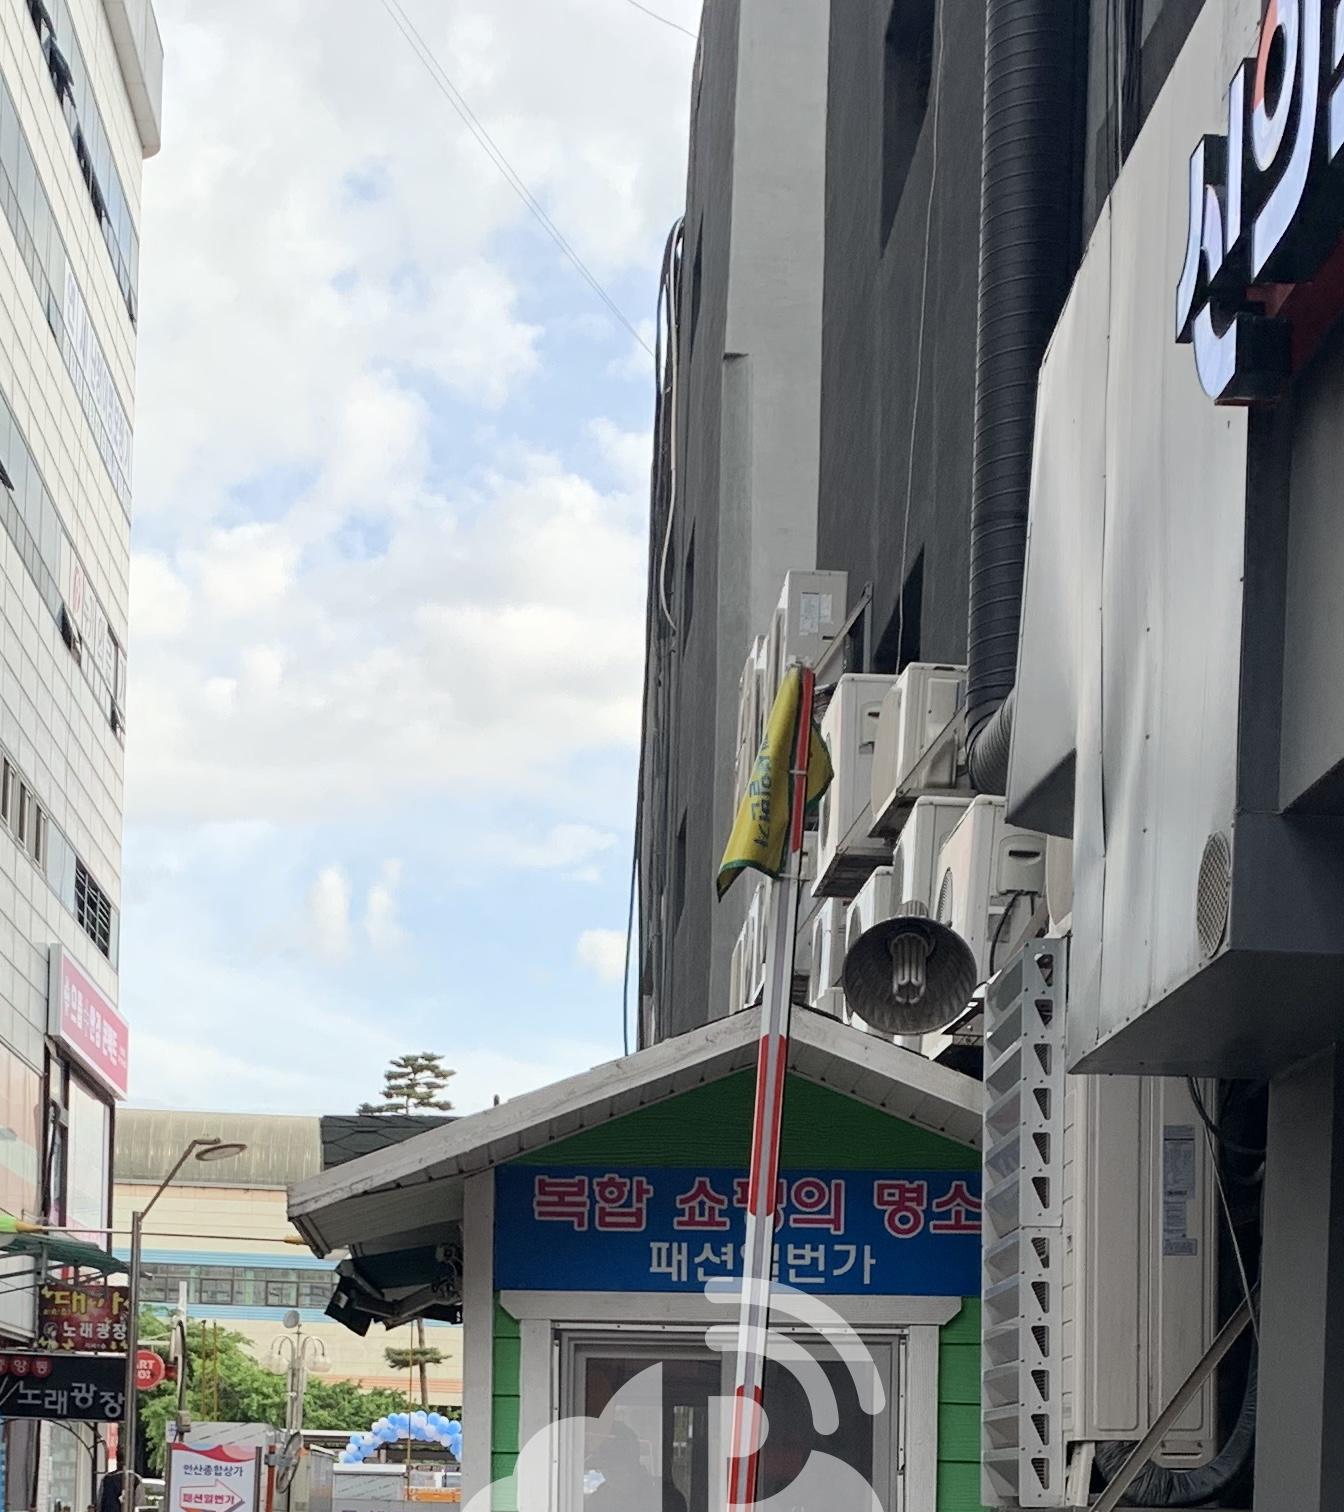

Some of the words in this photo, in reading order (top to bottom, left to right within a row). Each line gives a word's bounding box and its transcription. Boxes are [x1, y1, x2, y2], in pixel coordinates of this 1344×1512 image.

[534, 1174, 653, 1231] 복합
[873, 1180, 982, 1239] 명소
[62, 1321, 127, 1340] 노래광장
[17, 1381, 125, 1418] 노래광장
[183, 1464, 244, 1477] 안산종합상가
